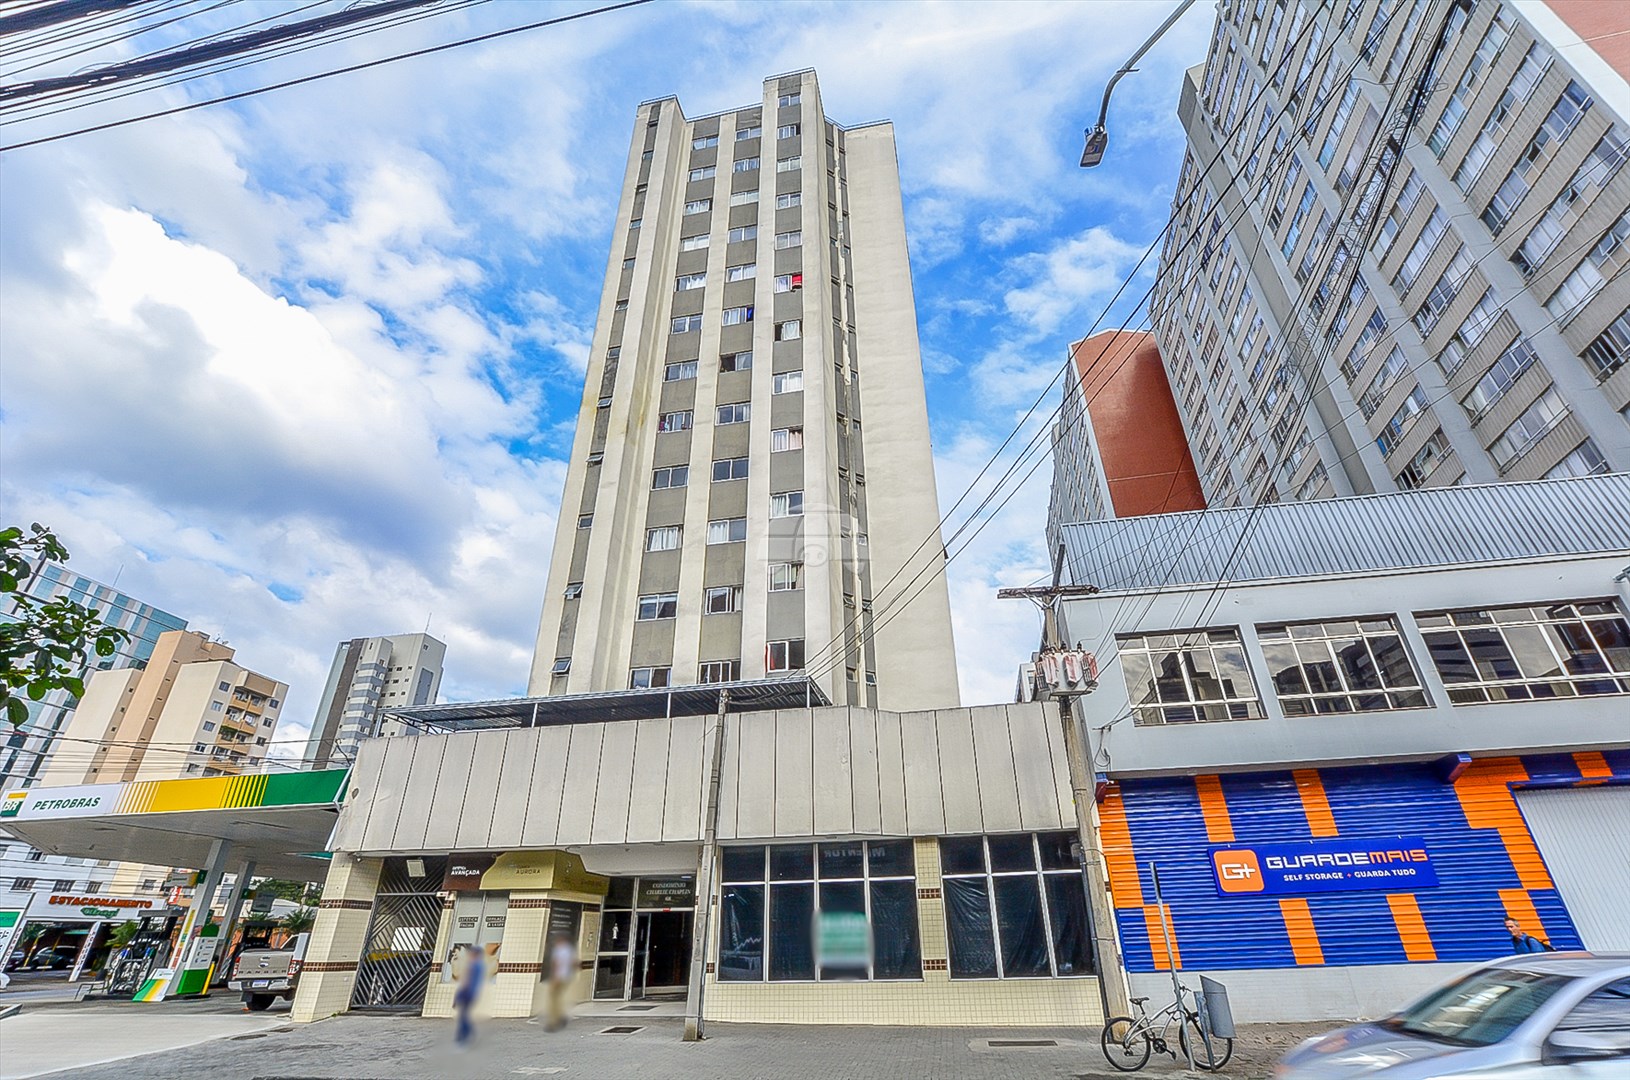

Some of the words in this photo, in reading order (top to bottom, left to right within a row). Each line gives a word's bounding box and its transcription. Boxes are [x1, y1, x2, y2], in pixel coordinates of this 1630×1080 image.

[32, 797, 101, 811] PETROBRAS
[450, 869, 481, 877] AVANÇADA
[1283, 874, 1303, 882] SELF
[1305, 872, 1344, 880] STORAGE
[1354, 869, 1391, 878] GUARDA
[1393, 868, 1416, 876] TUDO
[48, 895, 152, 909] ESTACIONAMENTO
